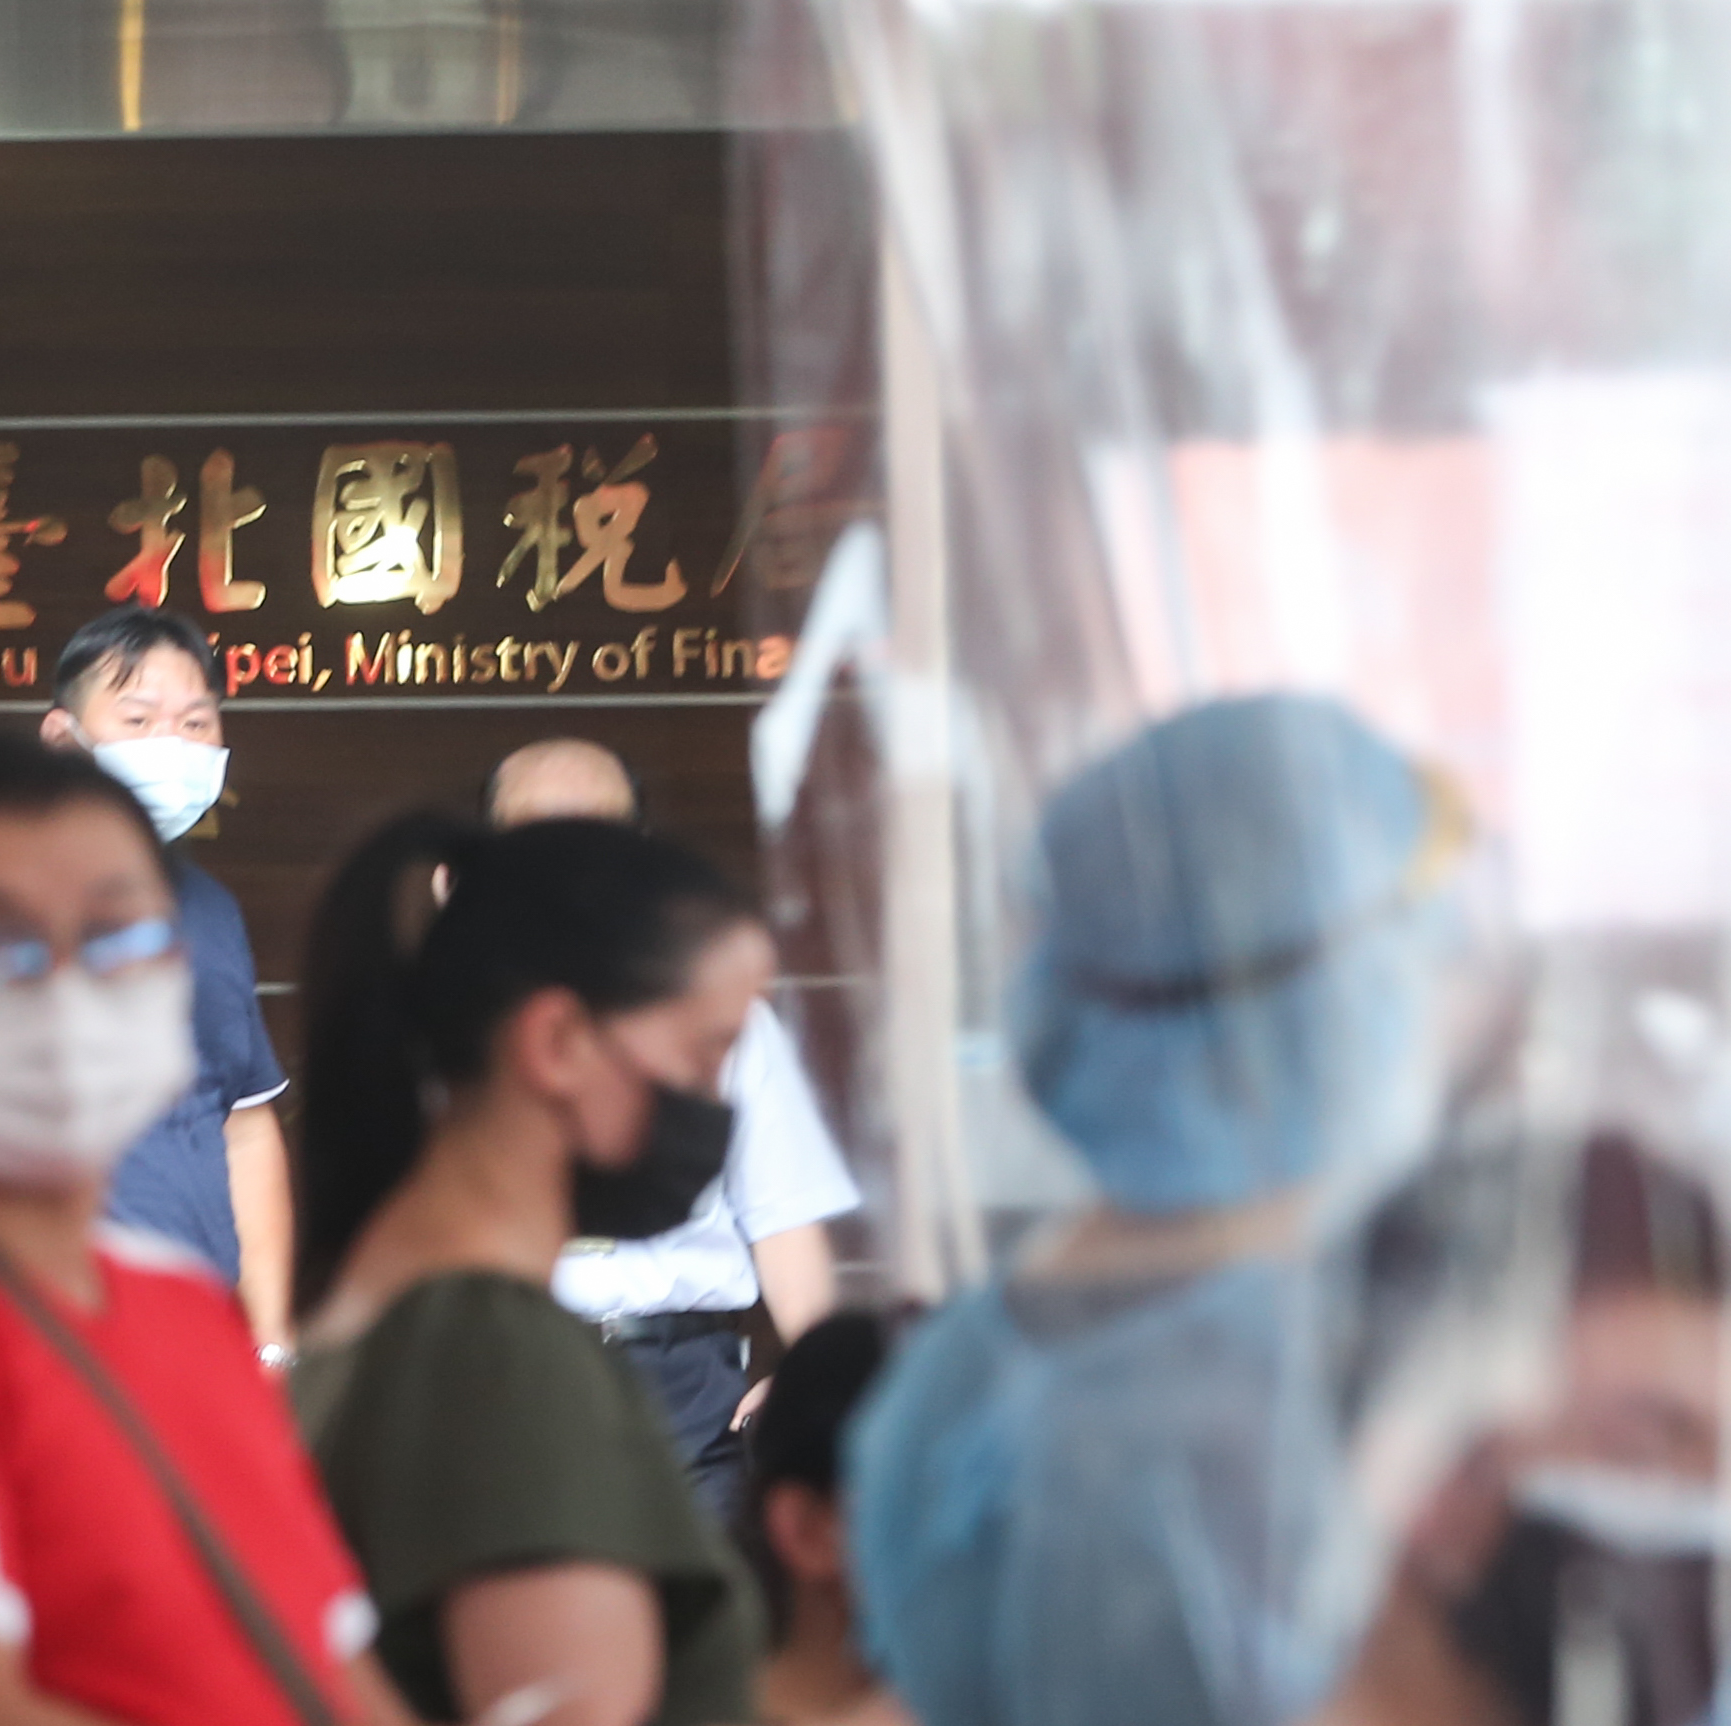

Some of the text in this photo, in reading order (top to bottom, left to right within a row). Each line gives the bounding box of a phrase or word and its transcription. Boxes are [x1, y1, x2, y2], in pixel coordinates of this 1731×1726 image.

[344, 628, 580, 693] Ministry
[591, 625, 659, 682] of
[671, 625, 797, 681] Fina
